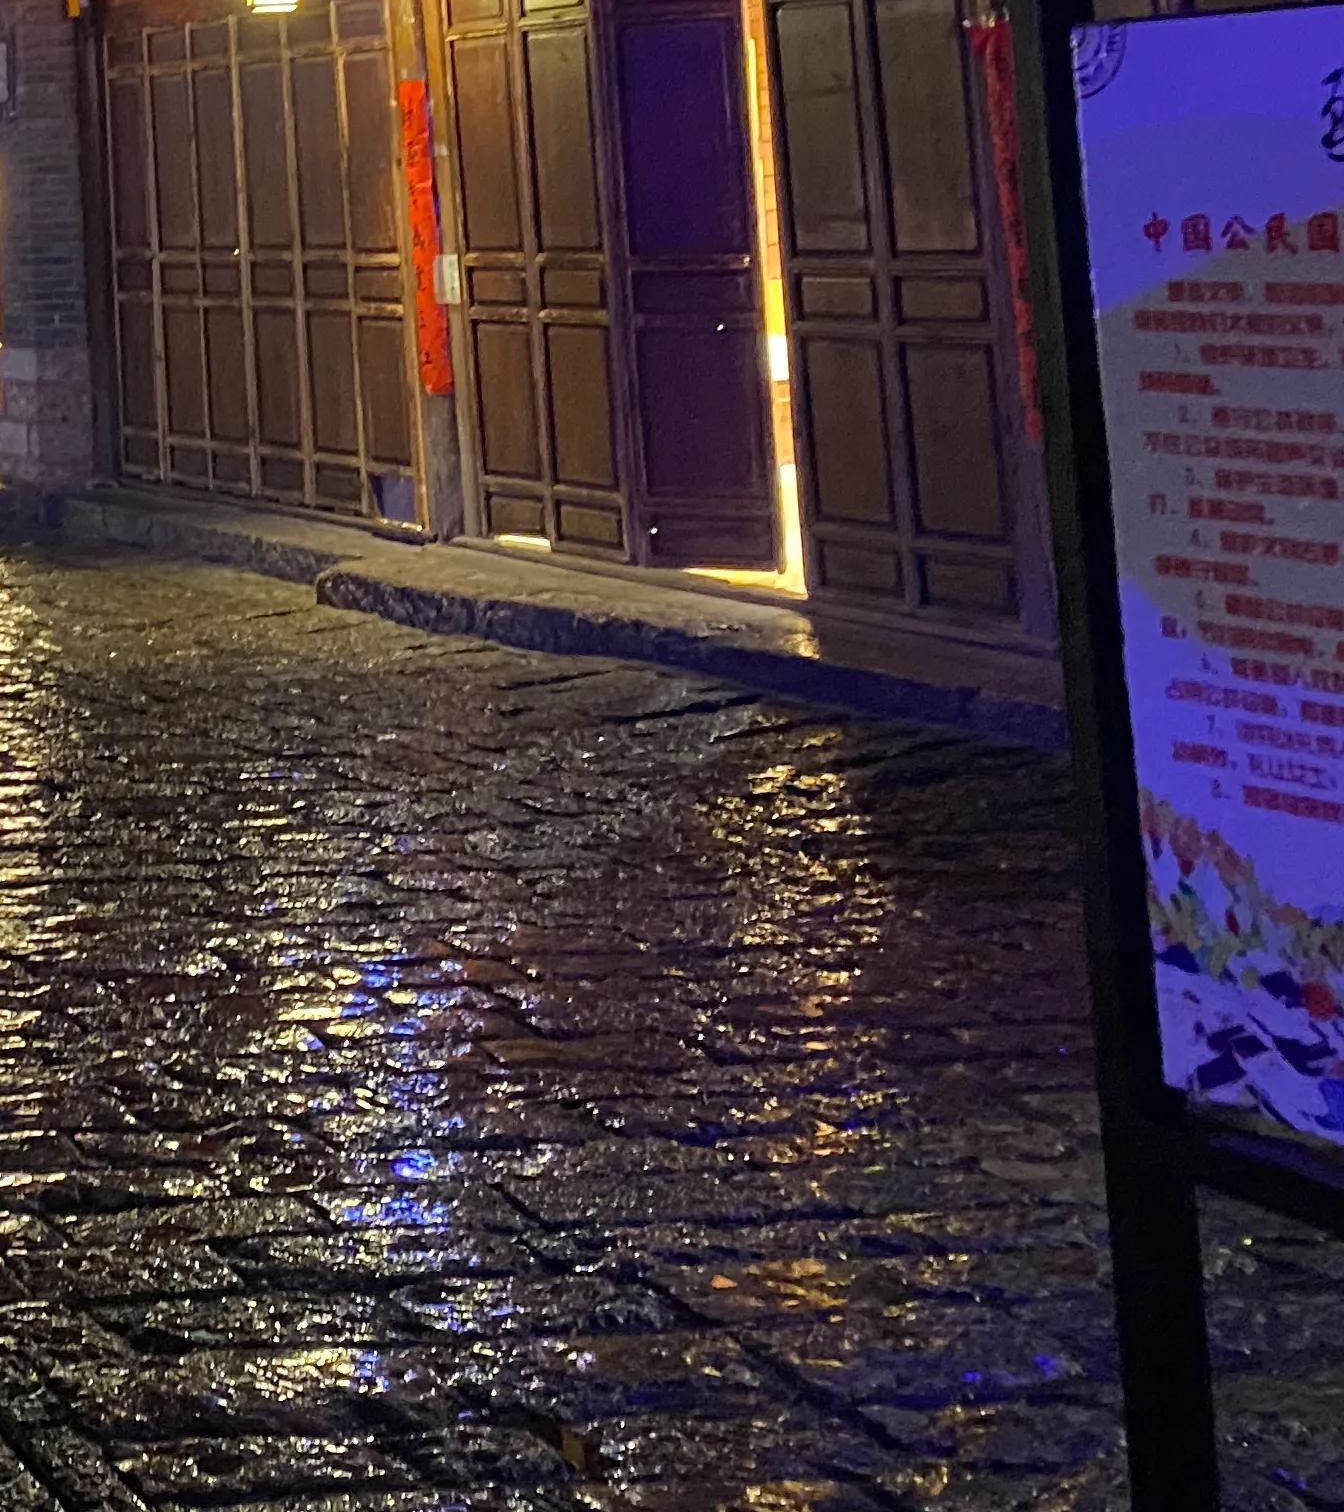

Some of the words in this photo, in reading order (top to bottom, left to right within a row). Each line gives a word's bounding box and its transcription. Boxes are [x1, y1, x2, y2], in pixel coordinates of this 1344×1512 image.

[1142, 210, 1340, 255] 中国公民国
